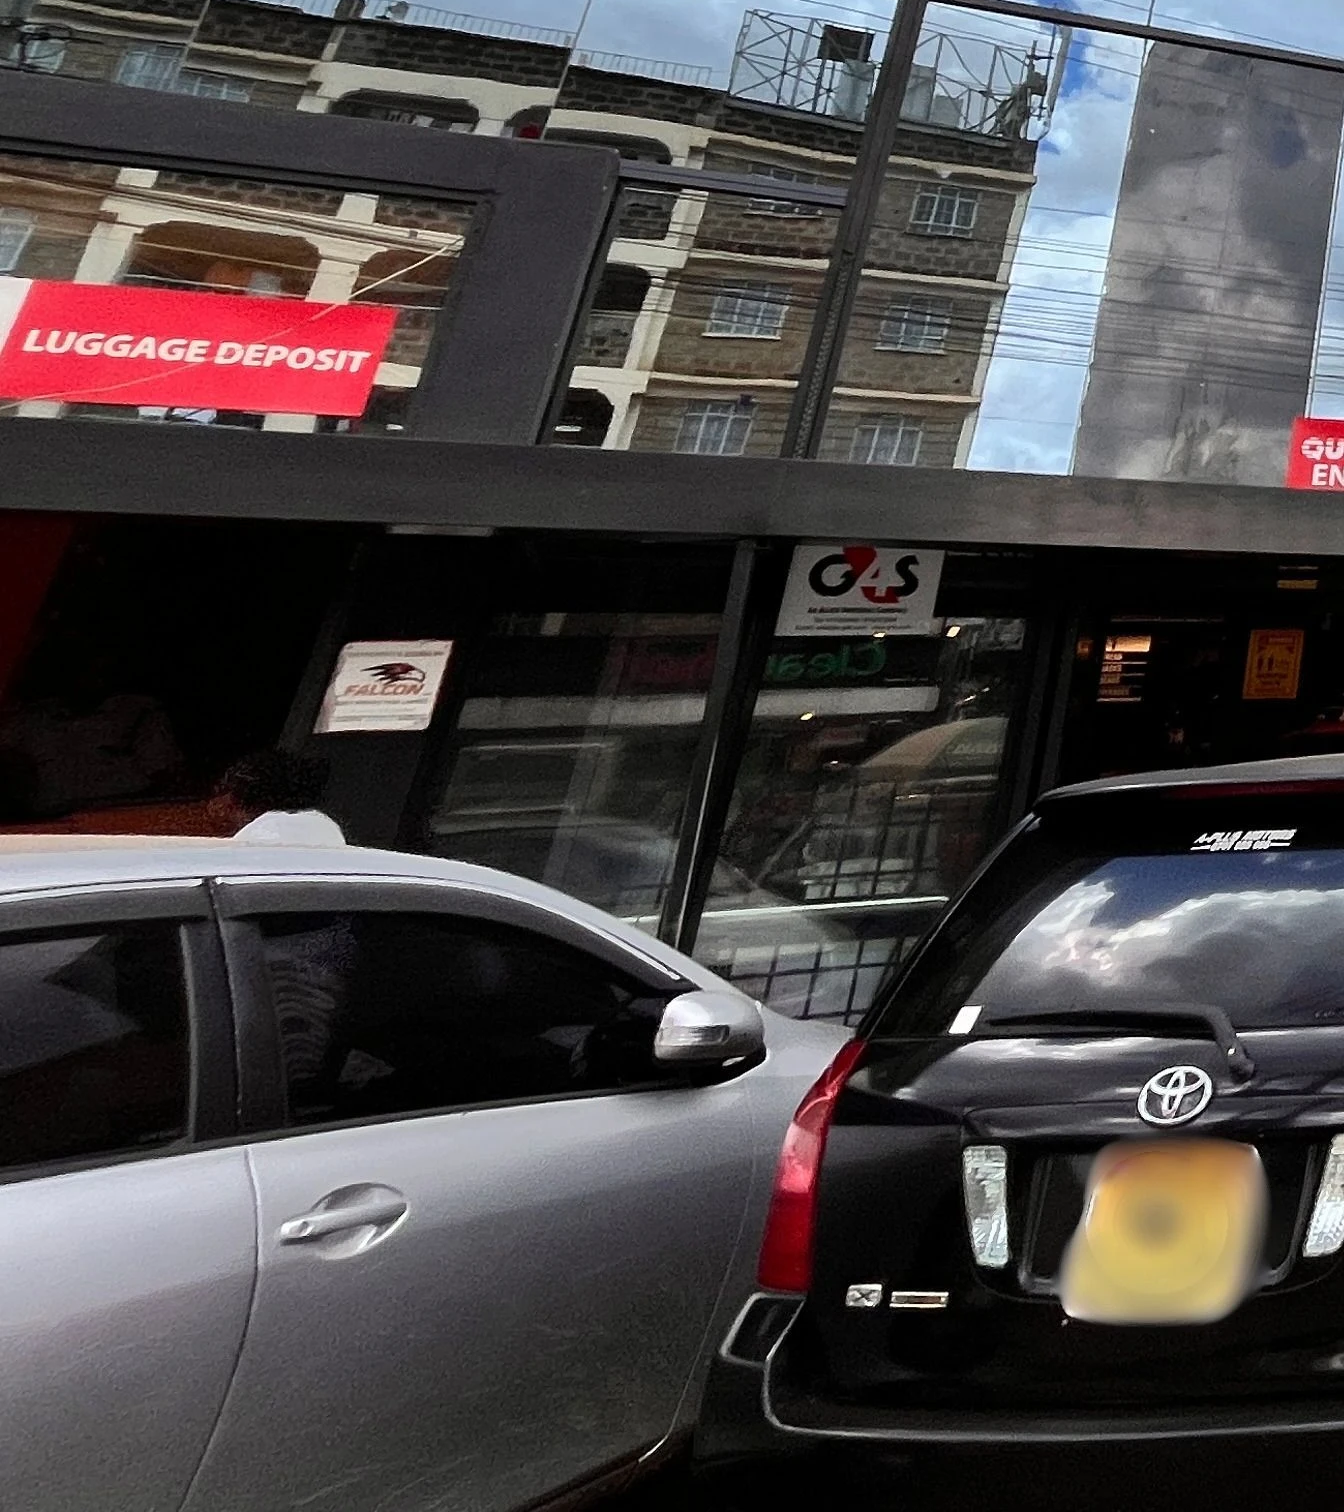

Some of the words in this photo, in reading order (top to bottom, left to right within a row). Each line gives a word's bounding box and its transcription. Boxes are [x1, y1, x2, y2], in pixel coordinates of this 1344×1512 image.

[23, 329, 210, 364] LUGGAGE
[214, 341, 371, 373] DEPOSIT
[808, 546, 919, 604] G4S
[344, 684, 424, 696] FALCON
